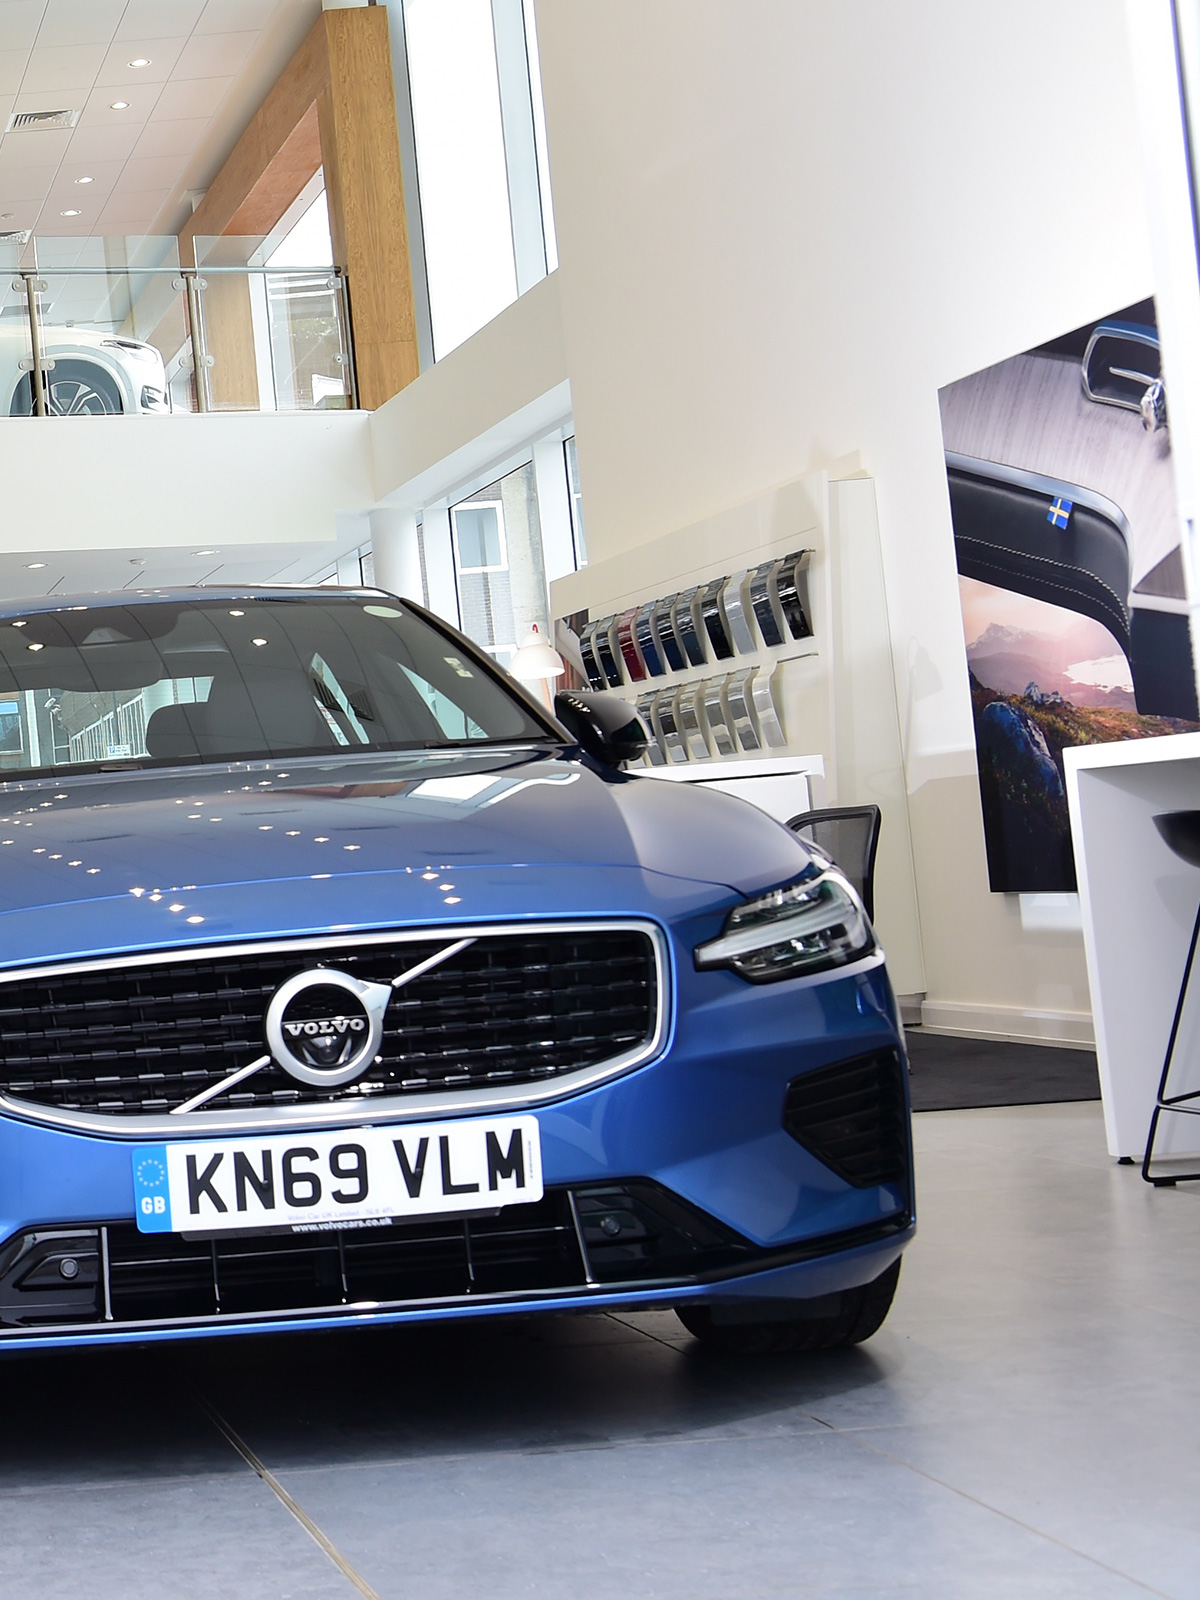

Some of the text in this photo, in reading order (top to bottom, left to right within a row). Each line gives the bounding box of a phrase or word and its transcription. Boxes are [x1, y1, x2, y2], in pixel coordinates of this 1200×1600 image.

[284, 1018, 365, 1036] VOLVO
[185, 1143, 369, 1215] KN69
[392, 1128, 526, 1198] VLM
[141, 1196, 166, 1215] GB
[291, 1217, 393, 1232] www.volvocars.co.uk
